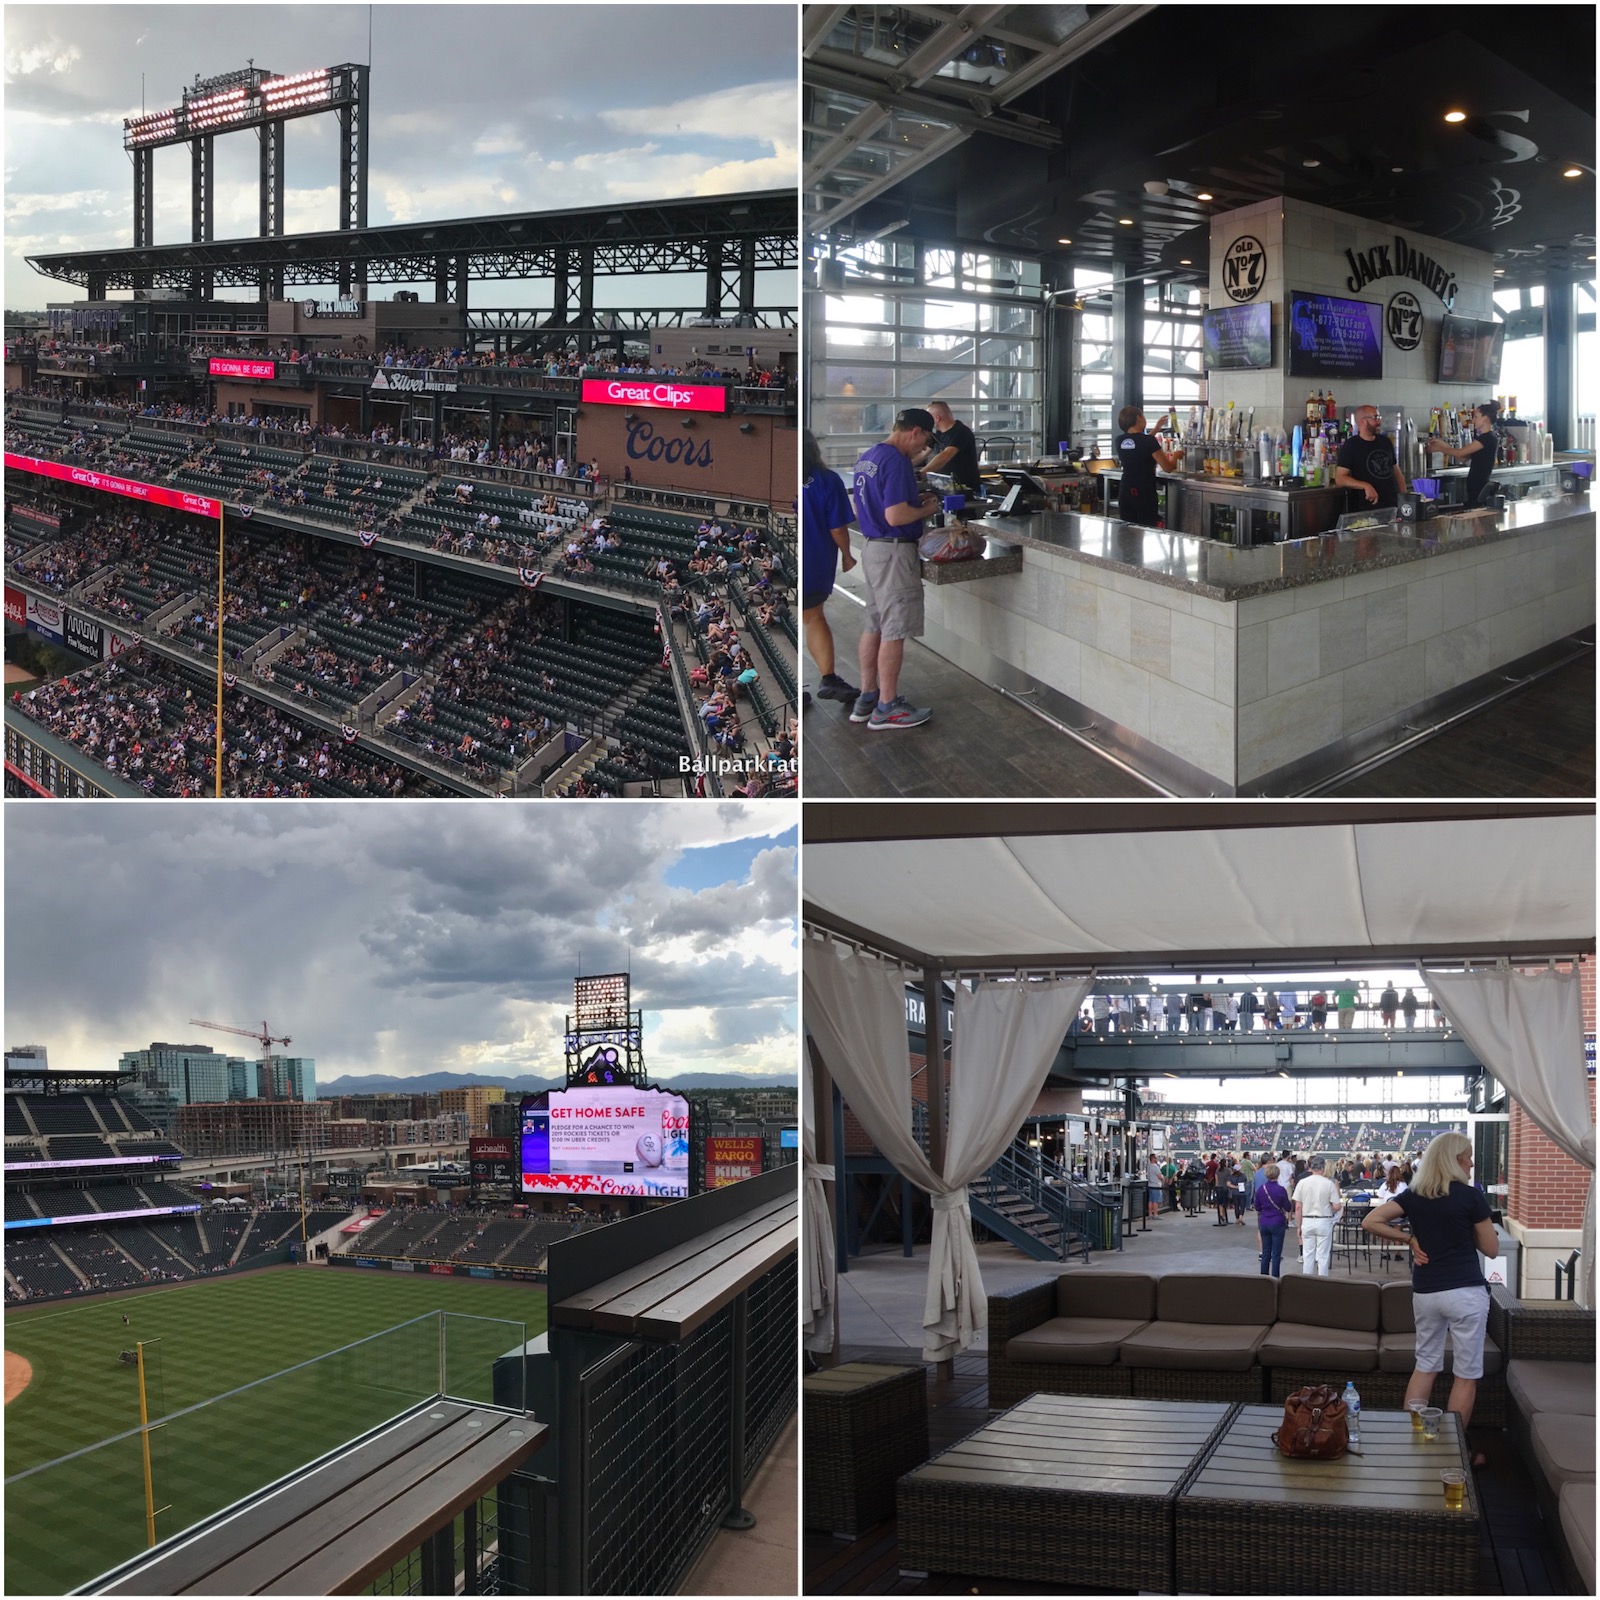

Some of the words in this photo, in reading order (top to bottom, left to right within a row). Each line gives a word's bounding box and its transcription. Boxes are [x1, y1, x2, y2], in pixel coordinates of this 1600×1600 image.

[1235, 242, 1253, 254] OLD
[1345, 245, 1393, 293] JACK
[1395, 235, 1459, 314] DANIEL'S
[1232, 286, 1257, 299] BRAND
[1308, 300, 1325, 310] Guest
[1398, 296, 1414, 307] OLD
[221, 363, 241, 374] GONNA
[242, 364, 251, 374] BE
[252, 365, 271, 375] GREAT
[390, 373, 424, 392] Silver
[608, 382, 651, 401] Great
[626, 421, 713, 467] Coors
[72, 469, 87, 481] Great
[86, 472, 100, 486] Clips
[110, 481, 125, 491] GONNA
[183, 494, 198, 506] Great
[198, 497, 211, 510] Clips
[67, 635, 78, 648] Five
[77, 640, 90, 655] Years
[89, 646, 99, 659] Out
[563, 1031, 640, 1054] ROCKIES
[551, 1108, 572, 1119] GET
[575, 1107, 612, 1118] HOME
[615, 1106, 645, 1117] SAFE
[475, 1143, 507, 1153] uchealth
[713, 1140, 755, 1149] WELLS
[714, 1151, 754, 1160] FARGO
[714, 1166, 752, 1177] KING
[600, 1179, 645, 1195] Coors
[647, 1185, 688, 1197] LIGHT
